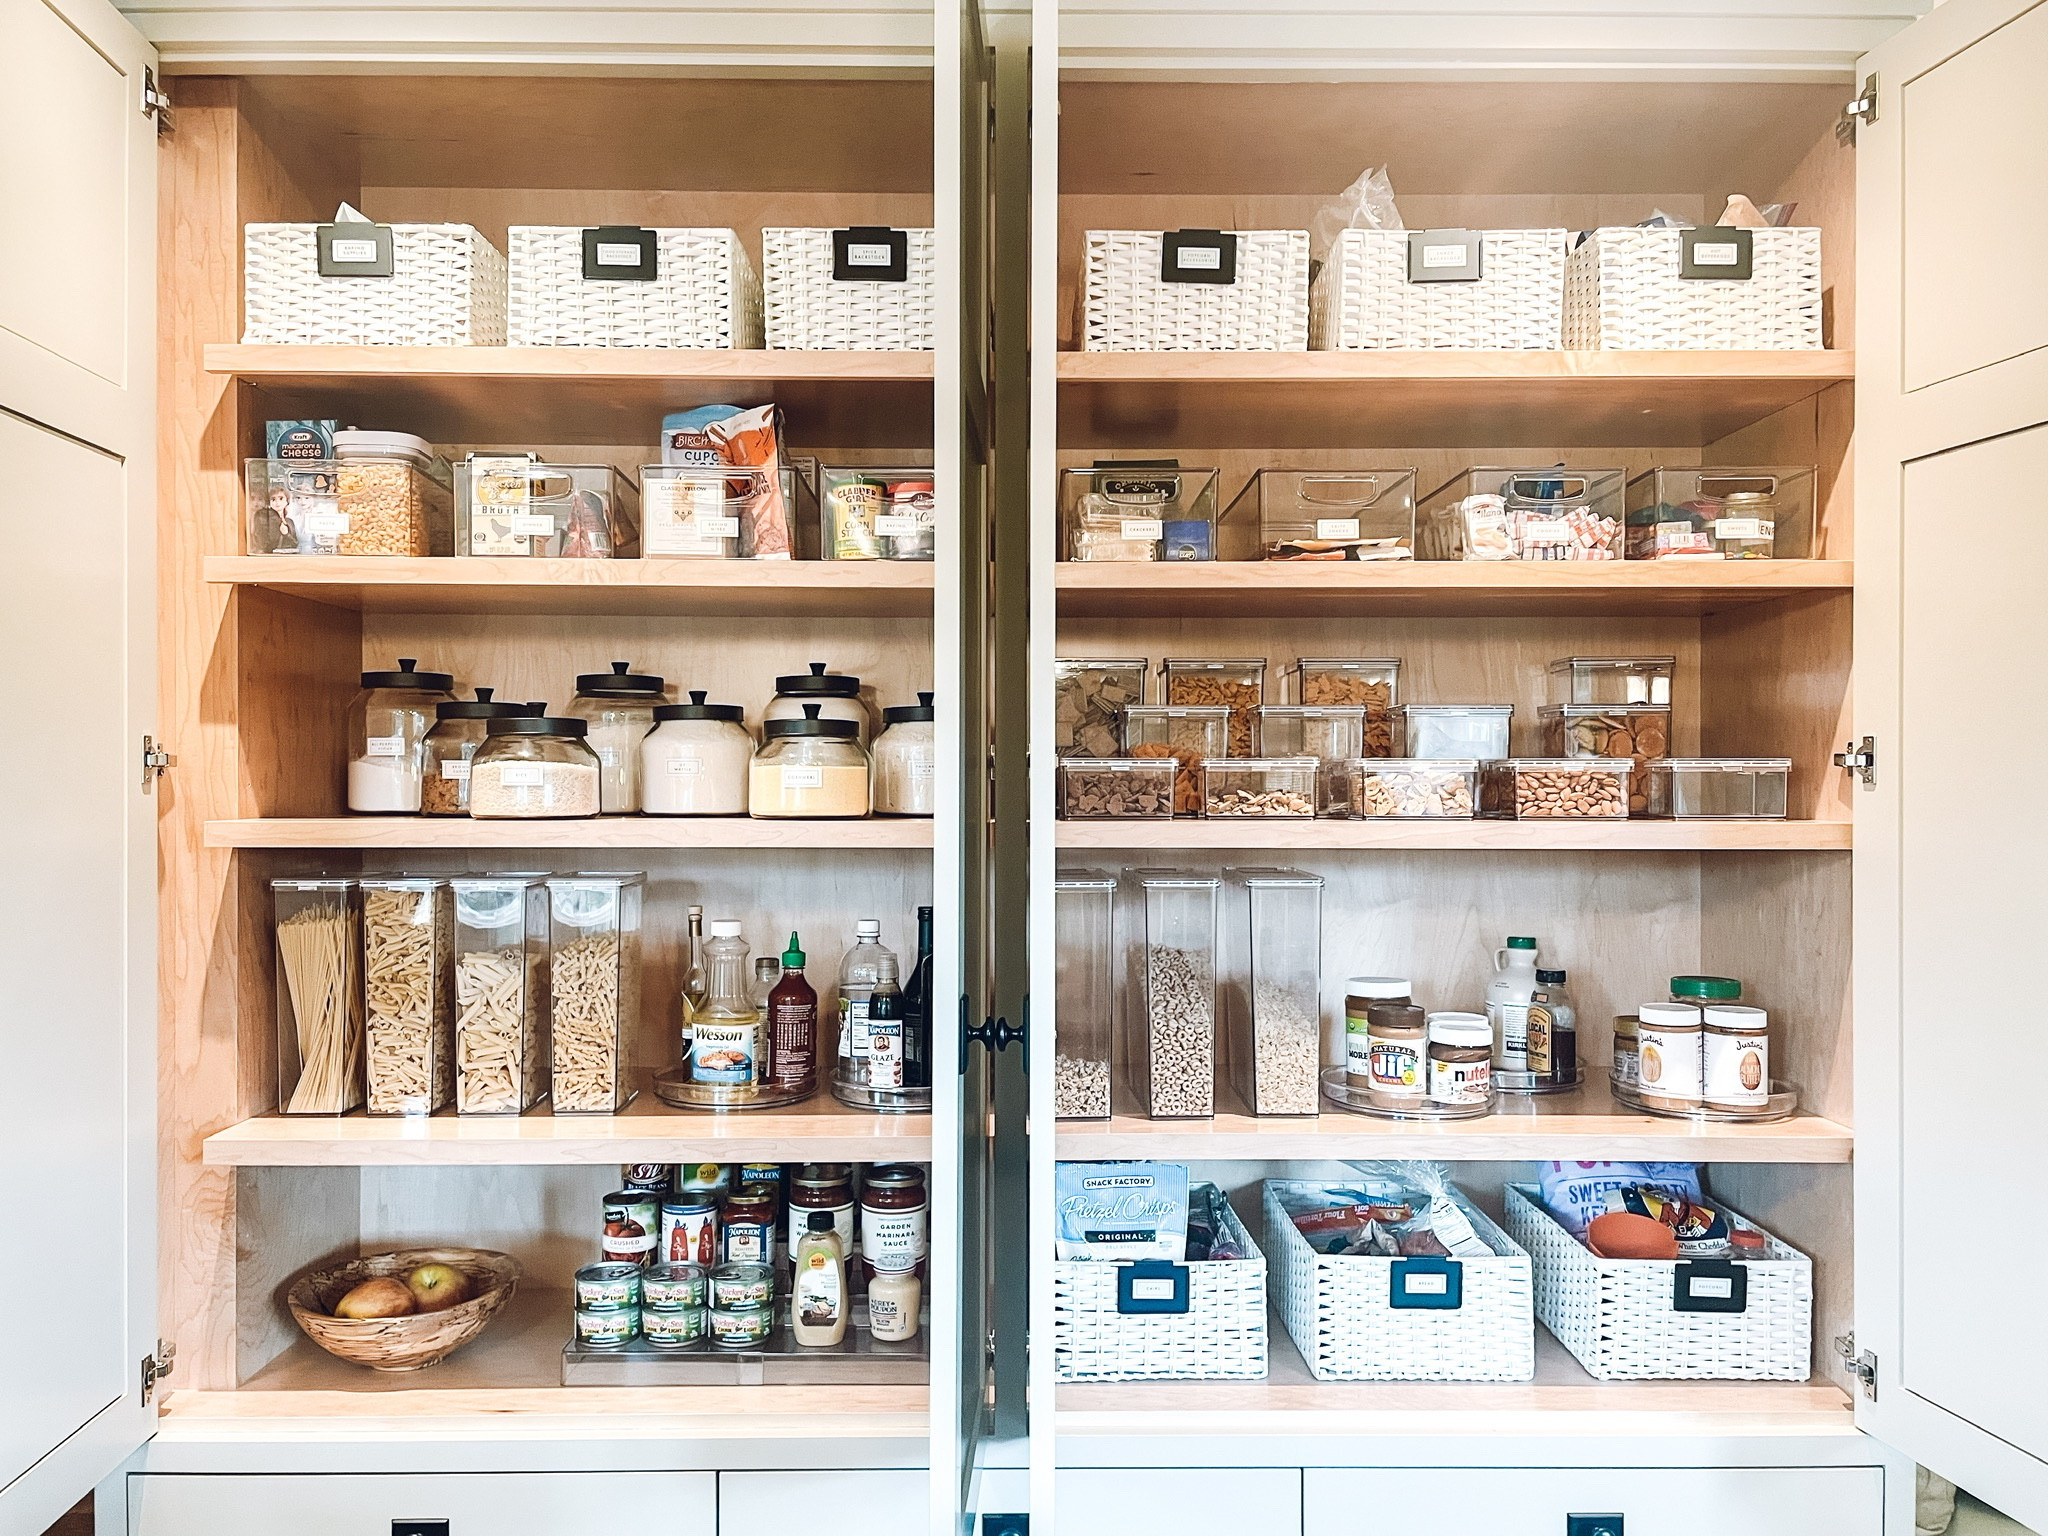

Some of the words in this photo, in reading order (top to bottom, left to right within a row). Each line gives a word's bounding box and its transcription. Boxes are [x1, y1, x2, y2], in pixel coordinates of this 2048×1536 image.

[675, 435, 709, 447] BIRCH
[841, 529, 875, 538] STACH
[695, 1027, 743, 1041] Wesson
[869, 1025, 900, 1036] NAPOLEON
[1529, 1022, 1547, 1036] LOCAL
[1641, 1034, 1664, 1047] Justin's
[1736, 1040, 1764, 1051] Justin's
[1349, 1050, 1368, 1060] MORE
[1373, 1045, 1412, 1055] NATURAL
[871, 1053, 894, 1062] GLAZE
[1373, 1053, 1417, 1078] Jif
[700, 1168, 716, 1176] wild
[742, 1170, 780, 1180] NAPOLEON
[1086, 1179, 1113, 1187] SNACK
[1114, 1178, 1151, 1186] FACTORY
[1062, 1195, 1124, 1229] Pretzel
[1122, 1193, 1179, 1223] Crisps
[1324, 1210, 1346, 1219] Flour
[729, 1229, 761, 1237] NAPOLEON
[1097, 1233, 1144, 1241] ORIGINAL
[1678, 1242, 1697, 1251] White
[1698, 1241, 1726, 1251] Cheddar
